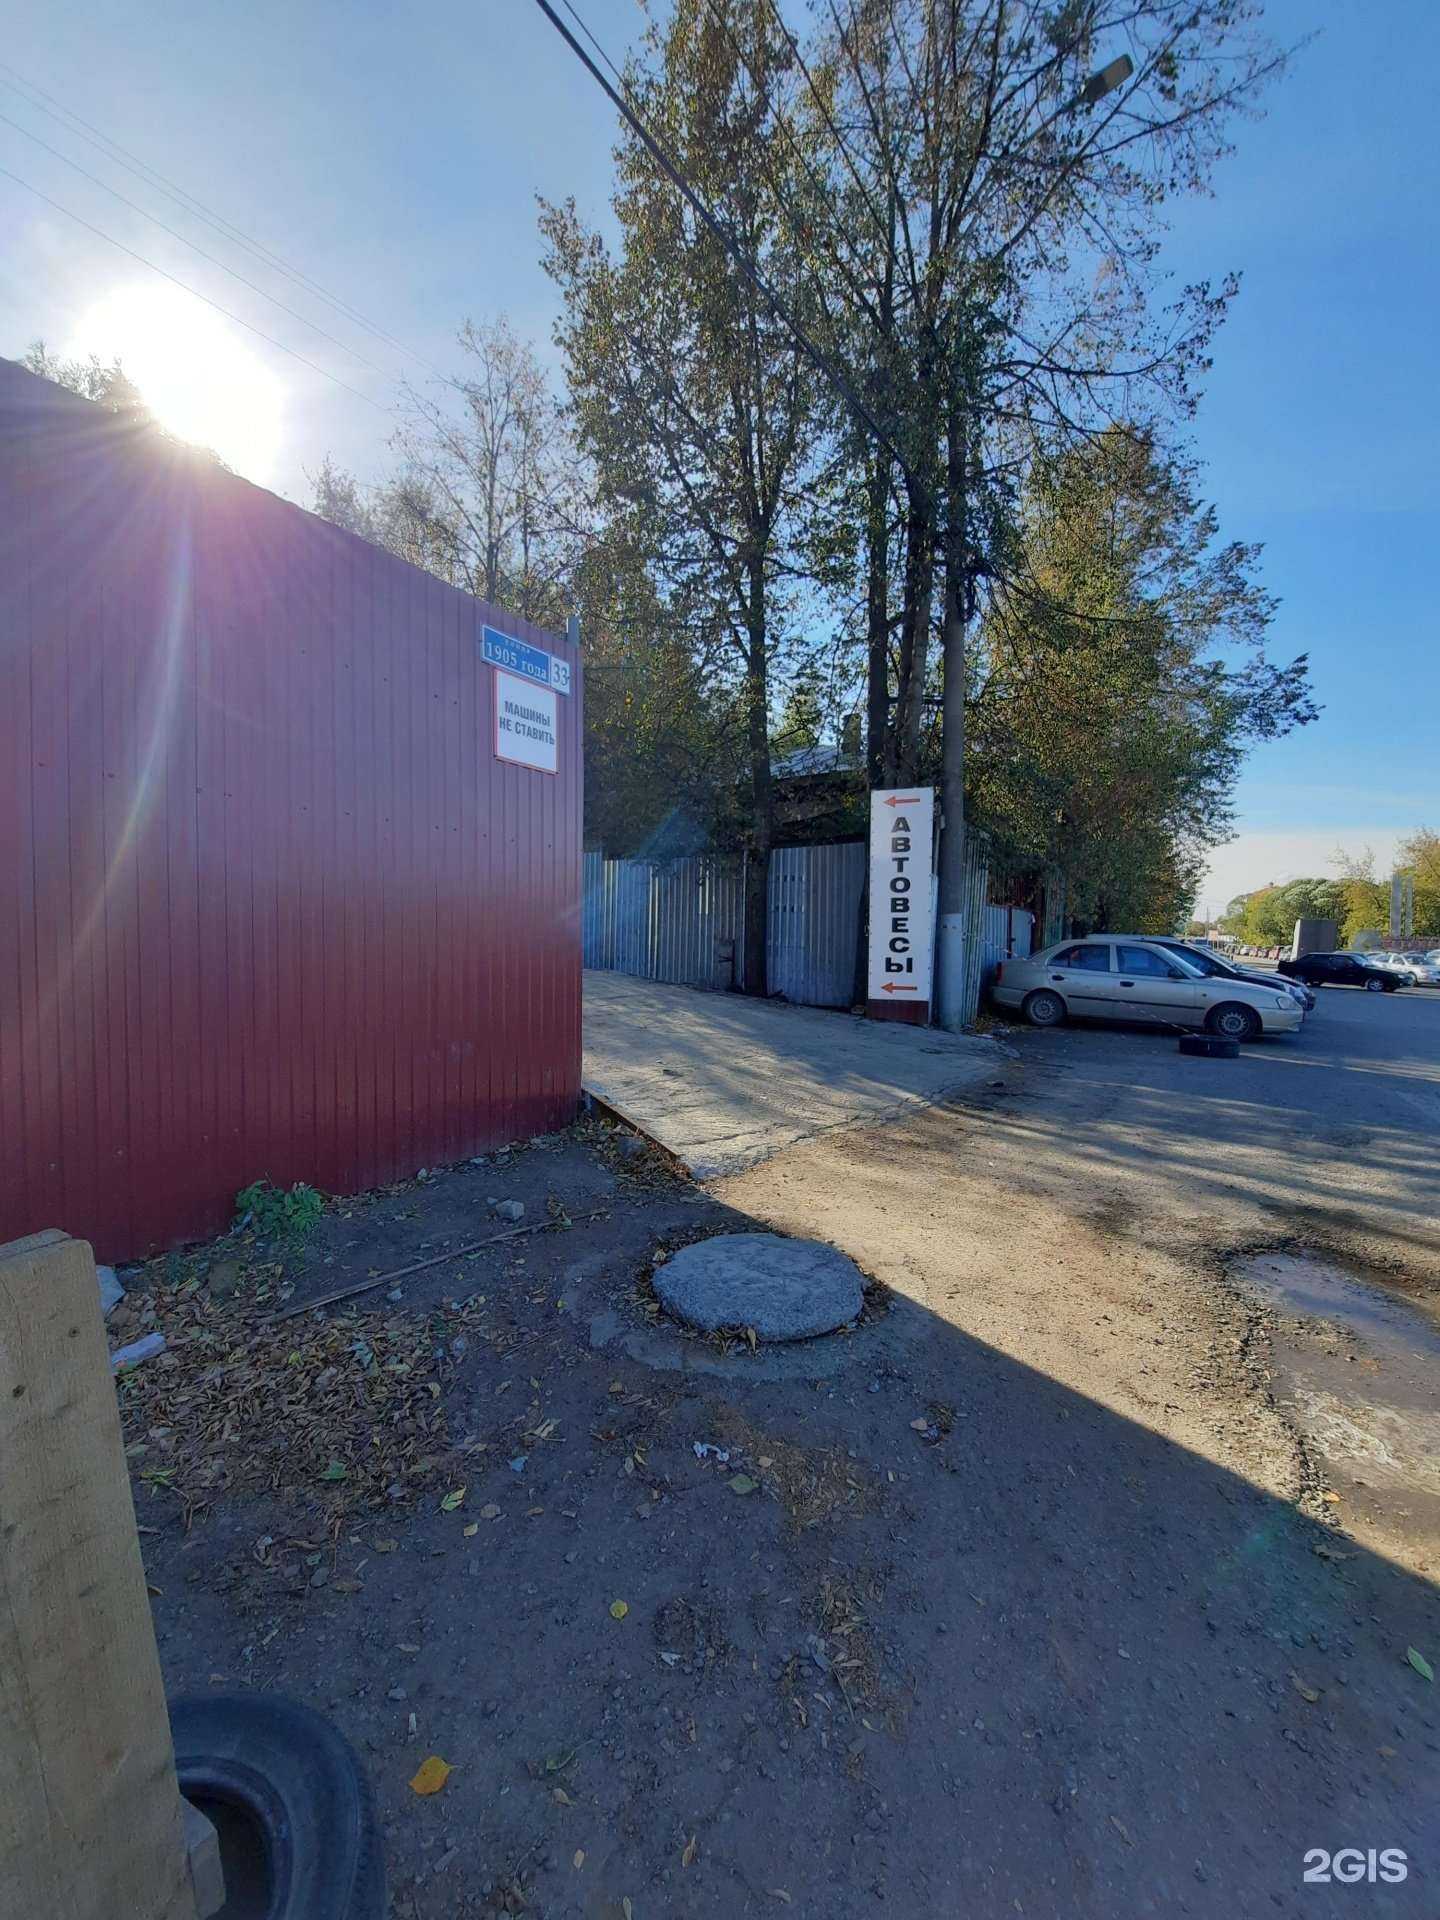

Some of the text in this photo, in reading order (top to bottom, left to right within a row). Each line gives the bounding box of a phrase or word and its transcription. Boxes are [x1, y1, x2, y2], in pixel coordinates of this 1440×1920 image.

[487, 642, 517, 666] 1905
[522, 661, 546, 679] года
[552, 663, 569, 687] 33
[505, 701, 551, 726] МАШИНЫ
[499, 717, 555, 745] НЕ СТАВИТЬ
[885, 816, 913, 973] АВТОВЕСЫ
